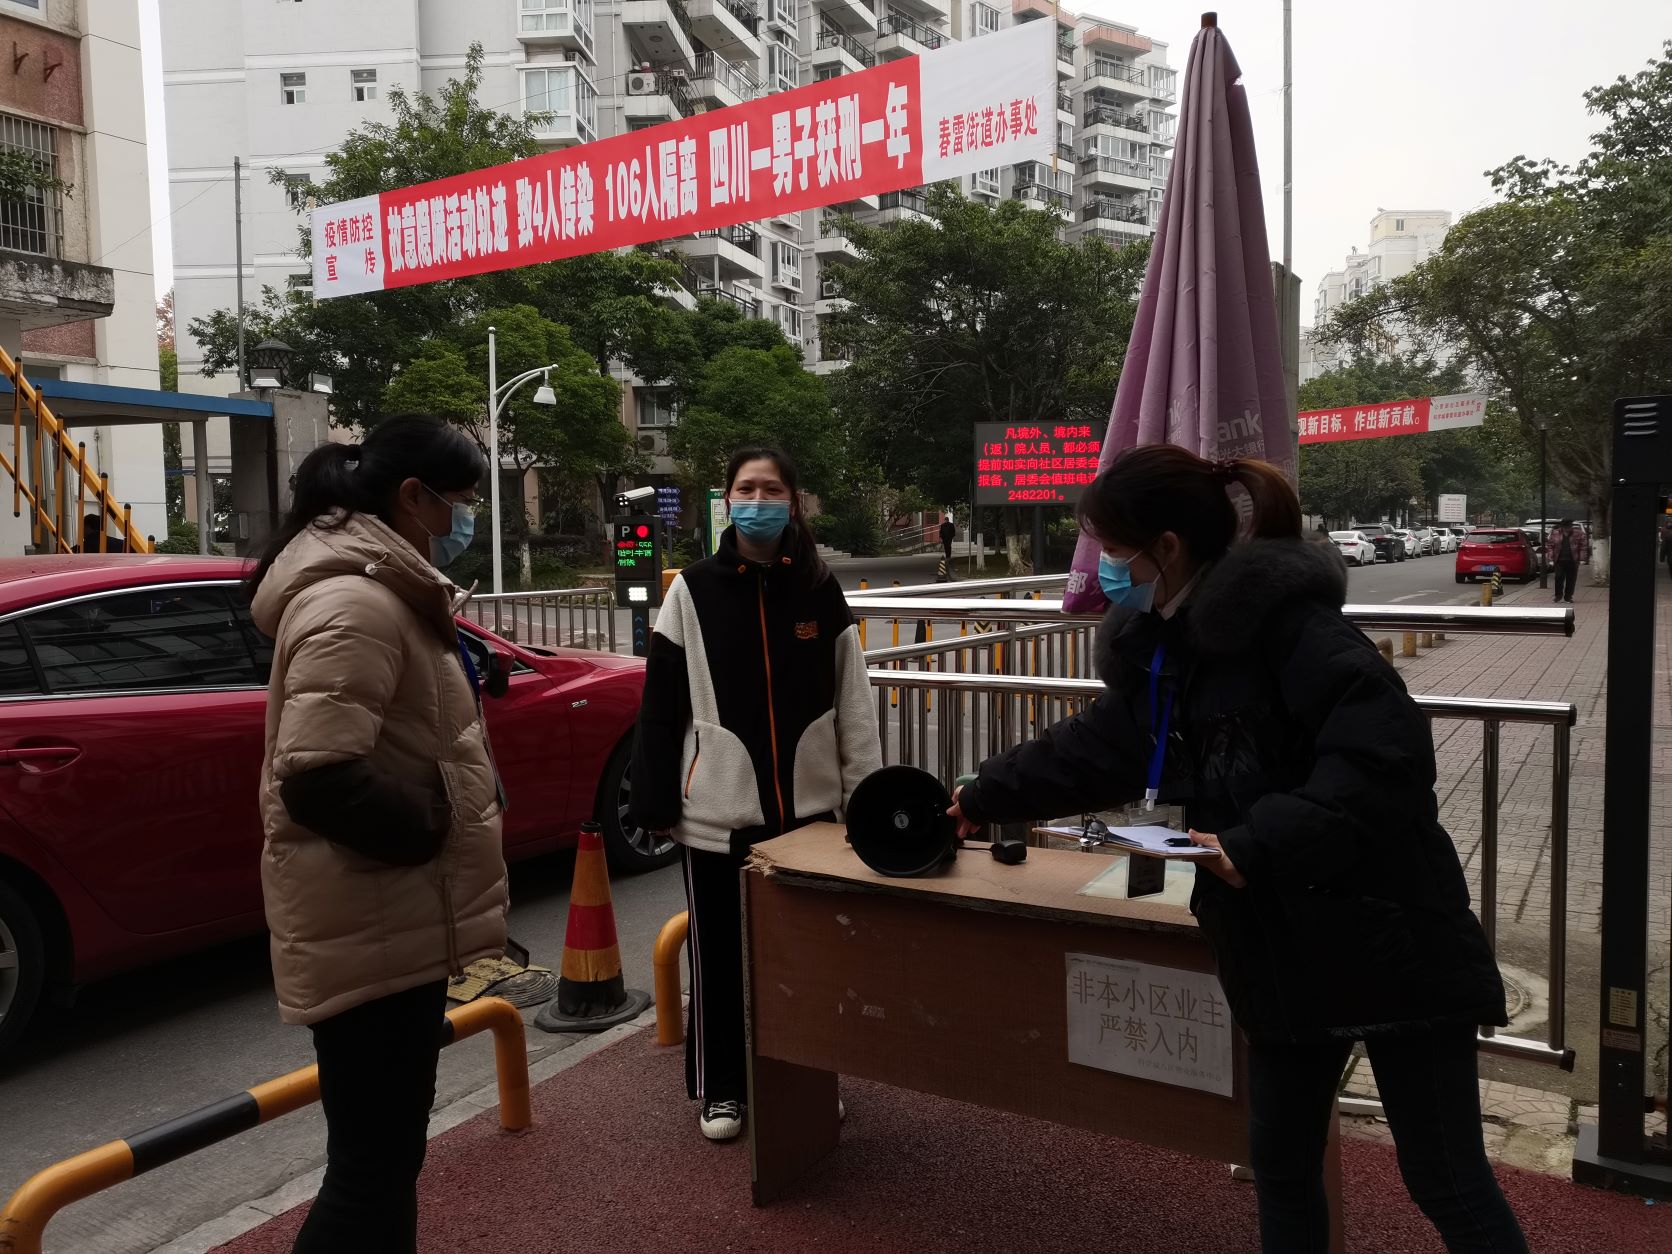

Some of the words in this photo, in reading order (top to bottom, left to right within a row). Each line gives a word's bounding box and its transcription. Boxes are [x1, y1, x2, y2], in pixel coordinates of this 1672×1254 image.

[938, 96, 1038, 158] 春雷街道办事处
[387, 180, 509, 273] 故意隐瞒活动轨迹
[605, 135, 698, 225] 106人隔离
[709, 82, 910, 208] 四川一男子获刑一年
[324, 212, 374, 248] 疫情防控
[978, 457, 1100, 471] 提前如实向社区居委会
[622, 525, 631, 538] P
[1072, 971, 1225, 1029] 非本小区业主
[1098, 1013, 1199, 1064] 严禁入内
